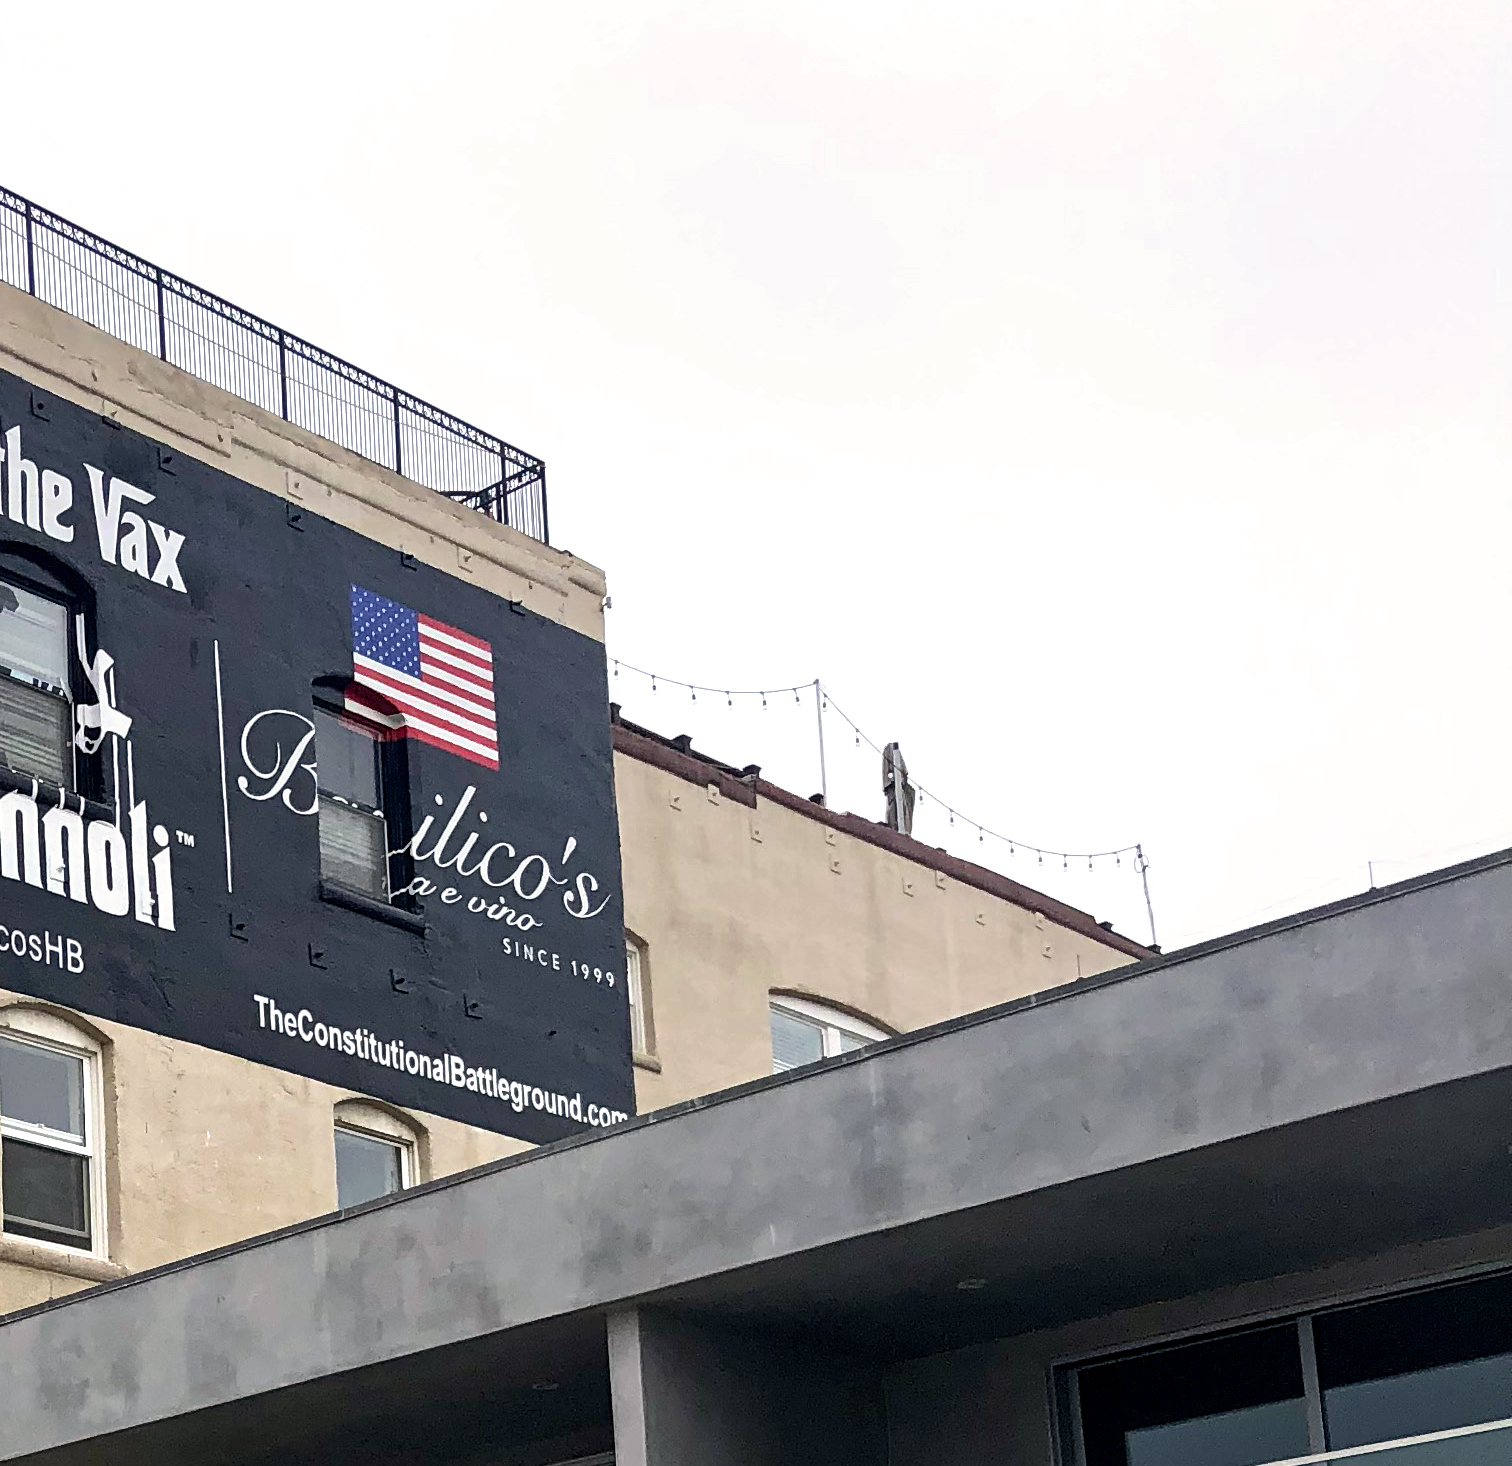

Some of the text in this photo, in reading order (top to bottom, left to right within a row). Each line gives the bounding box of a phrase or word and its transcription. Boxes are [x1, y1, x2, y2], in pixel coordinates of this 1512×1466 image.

[83, 463, 187, 593] Vax
[441, 887, 462, 903] e
[467, 896, 543, 931] vino
[503, 938, 615, 987] SINCE 1999
[254, 993, 628, 1127] TheConstitutionalBattleground.com
